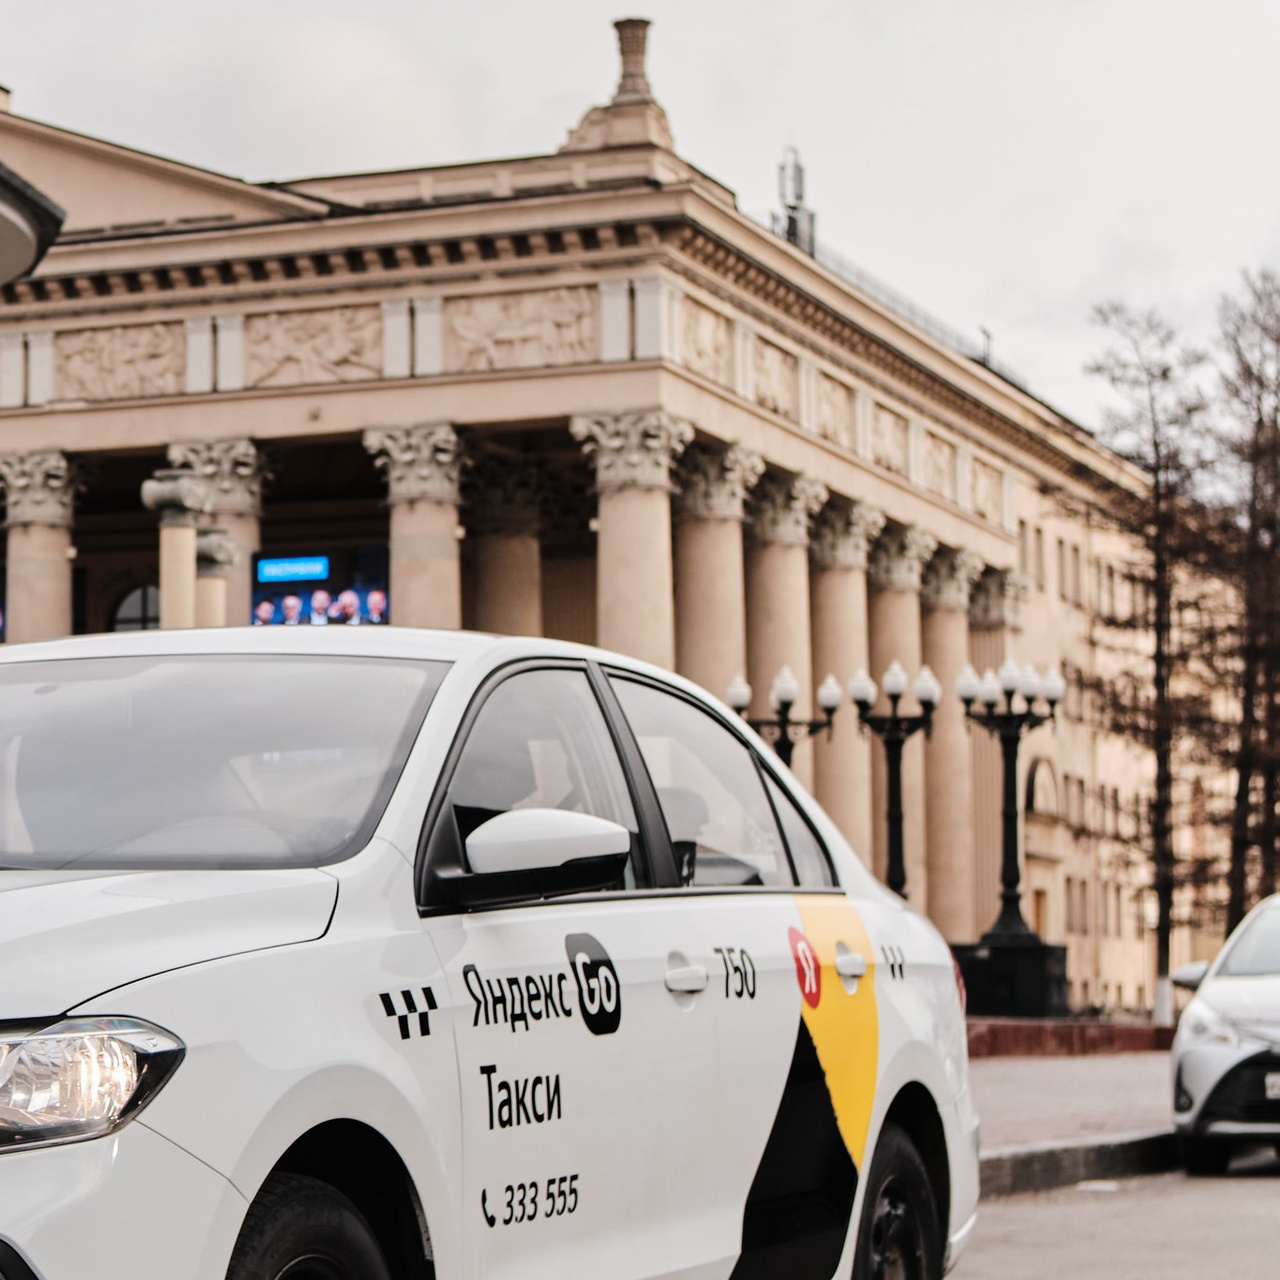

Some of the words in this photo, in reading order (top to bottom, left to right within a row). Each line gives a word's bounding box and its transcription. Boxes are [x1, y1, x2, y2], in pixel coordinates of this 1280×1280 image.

[462, 964, 572, 1032] Яндекс
[575, 951, 617, 1015] Go
[713, 947, 756, 999] 750
[480, 1064, 562, 1130] Такси
[503, 1181, 539, 1225] 333
[545, 1173, 579, 1218] 555
